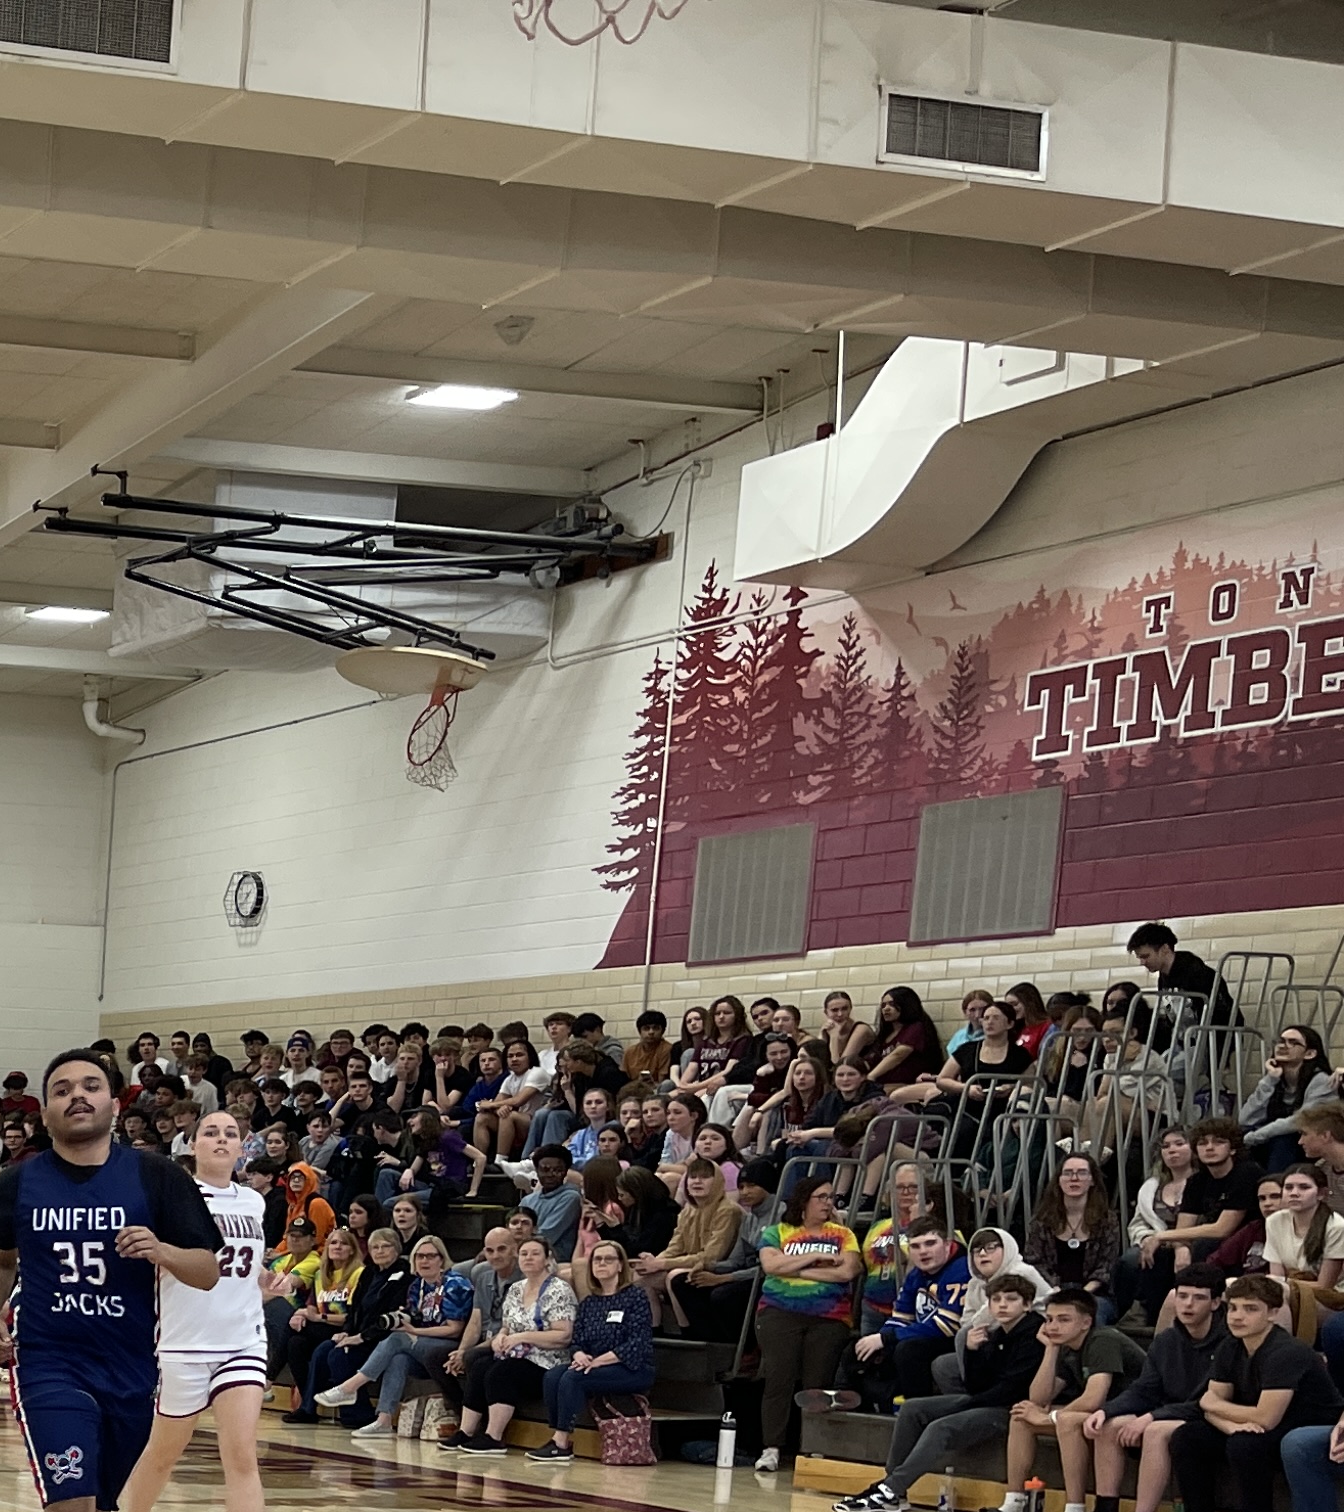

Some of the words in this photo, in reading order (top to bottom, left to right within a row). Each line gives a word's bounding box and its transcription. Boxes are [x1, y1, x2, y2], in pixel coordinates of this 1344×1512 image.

[33, 1206, 126, 1231] UNIFIED
[53, 1241, 107, 1286] 35
[219, 1245, 253, 1278] 23
[52, 1292, 125, 1317] JACKS
